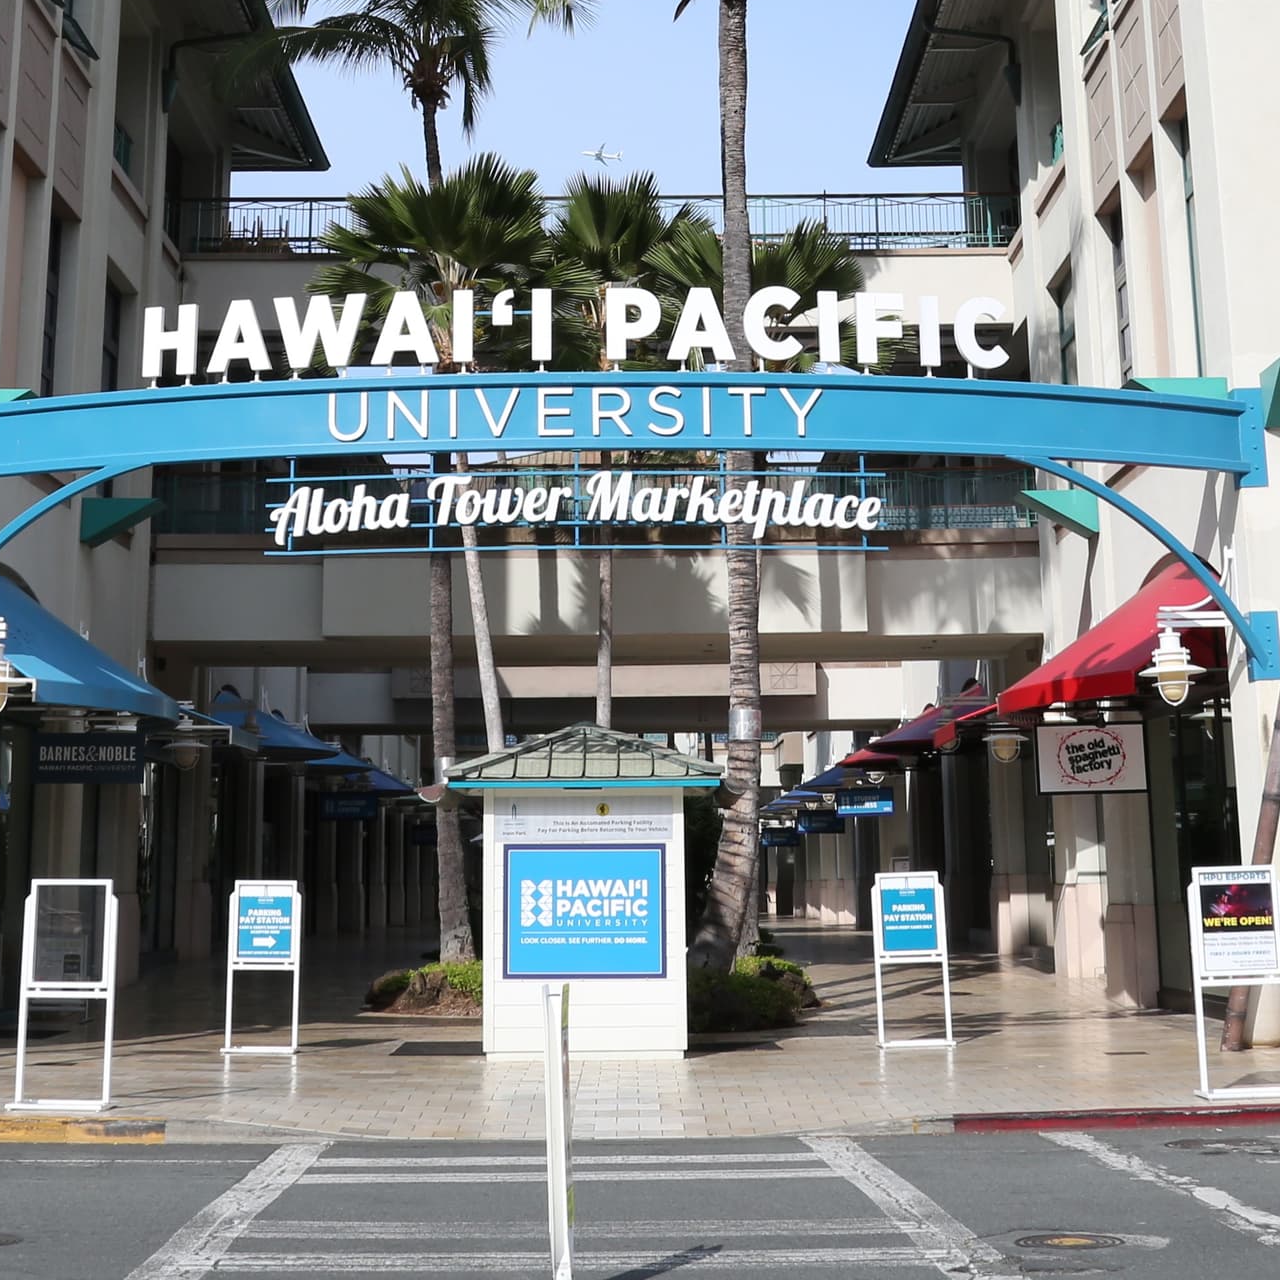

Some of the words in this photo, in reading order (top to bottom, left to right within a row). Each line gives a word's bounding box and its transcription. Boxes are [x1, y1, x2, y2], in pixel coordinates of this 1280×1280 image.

[605, 286, 1011, 370] PACIFIC
[328, 385, 823, 442] UNIVERSITY
[269, 483, 410, 547] Aloha
[427, 475, 572, 527] Tower
[586, 470, 882, 540] Marketplace
[1065, 743, 1085, 755] the
[1087, 737, 1106, 751] old
[1071, 758, 1112, 775] factory
[1203, 872, 1223, 881] HPU
[1225, 871, 1266, 881] ESPORTS
[248, 909, 282, 917] PARKING
[556, 899, 648, 917] PACIFIC
[892, 904, 926, 912] PARKING
[556, 919, 648, 927] UNIVERSITY
[884, 914, 900, 922] PAY
[901, 913, 933, 922] STATION
[1203, 917, 1238, 927] WE'RE
[1239, 916, 1272, 926] OPEN!
[540, 937, 567, 945] CLOSER.
